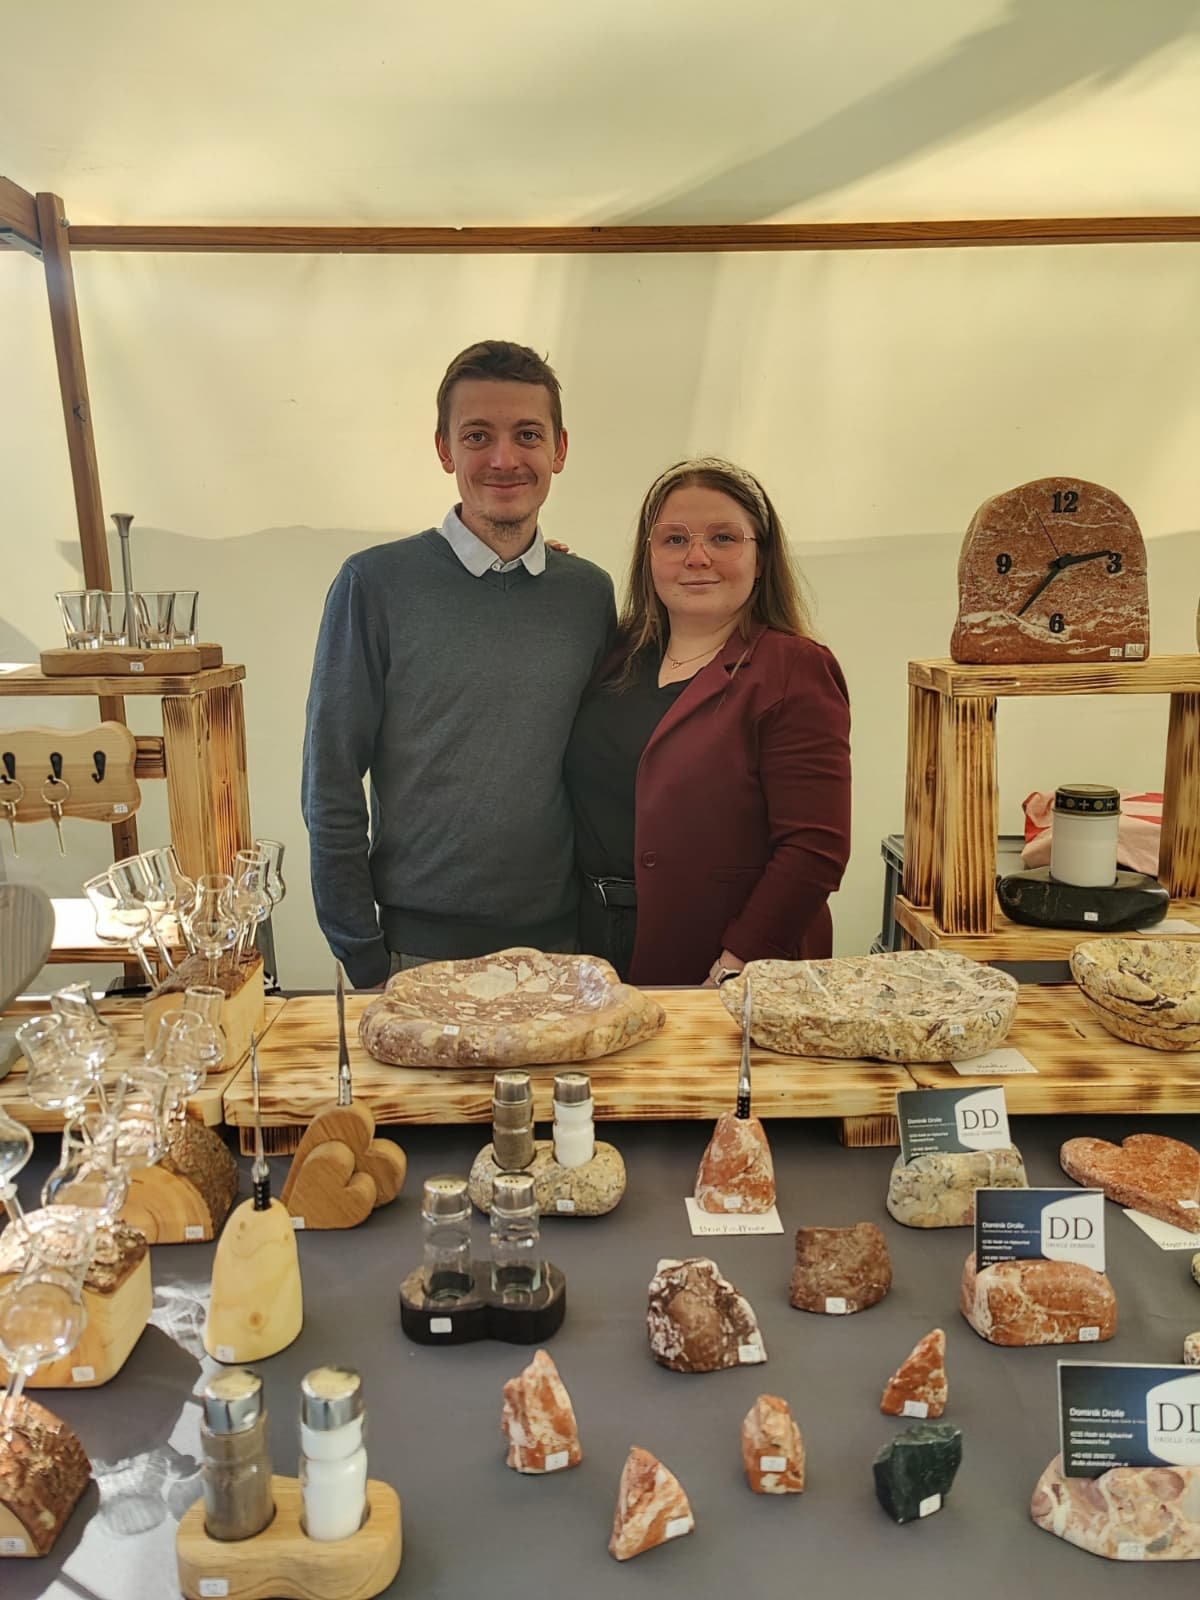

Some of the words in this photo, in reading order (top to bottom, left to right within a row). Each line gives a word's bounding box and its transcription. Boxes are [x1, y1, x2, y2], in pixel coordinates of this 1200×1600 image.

[1051, 491, 1079, 513] 12
[996, 553, 1012, 574] 9
[1106, 552, 1122, 574] 3
[1049, 613, 1065, 633] 6
[961, 1108, 999, 1130] DD
[1048, 1216, 1094, 1240] DD
